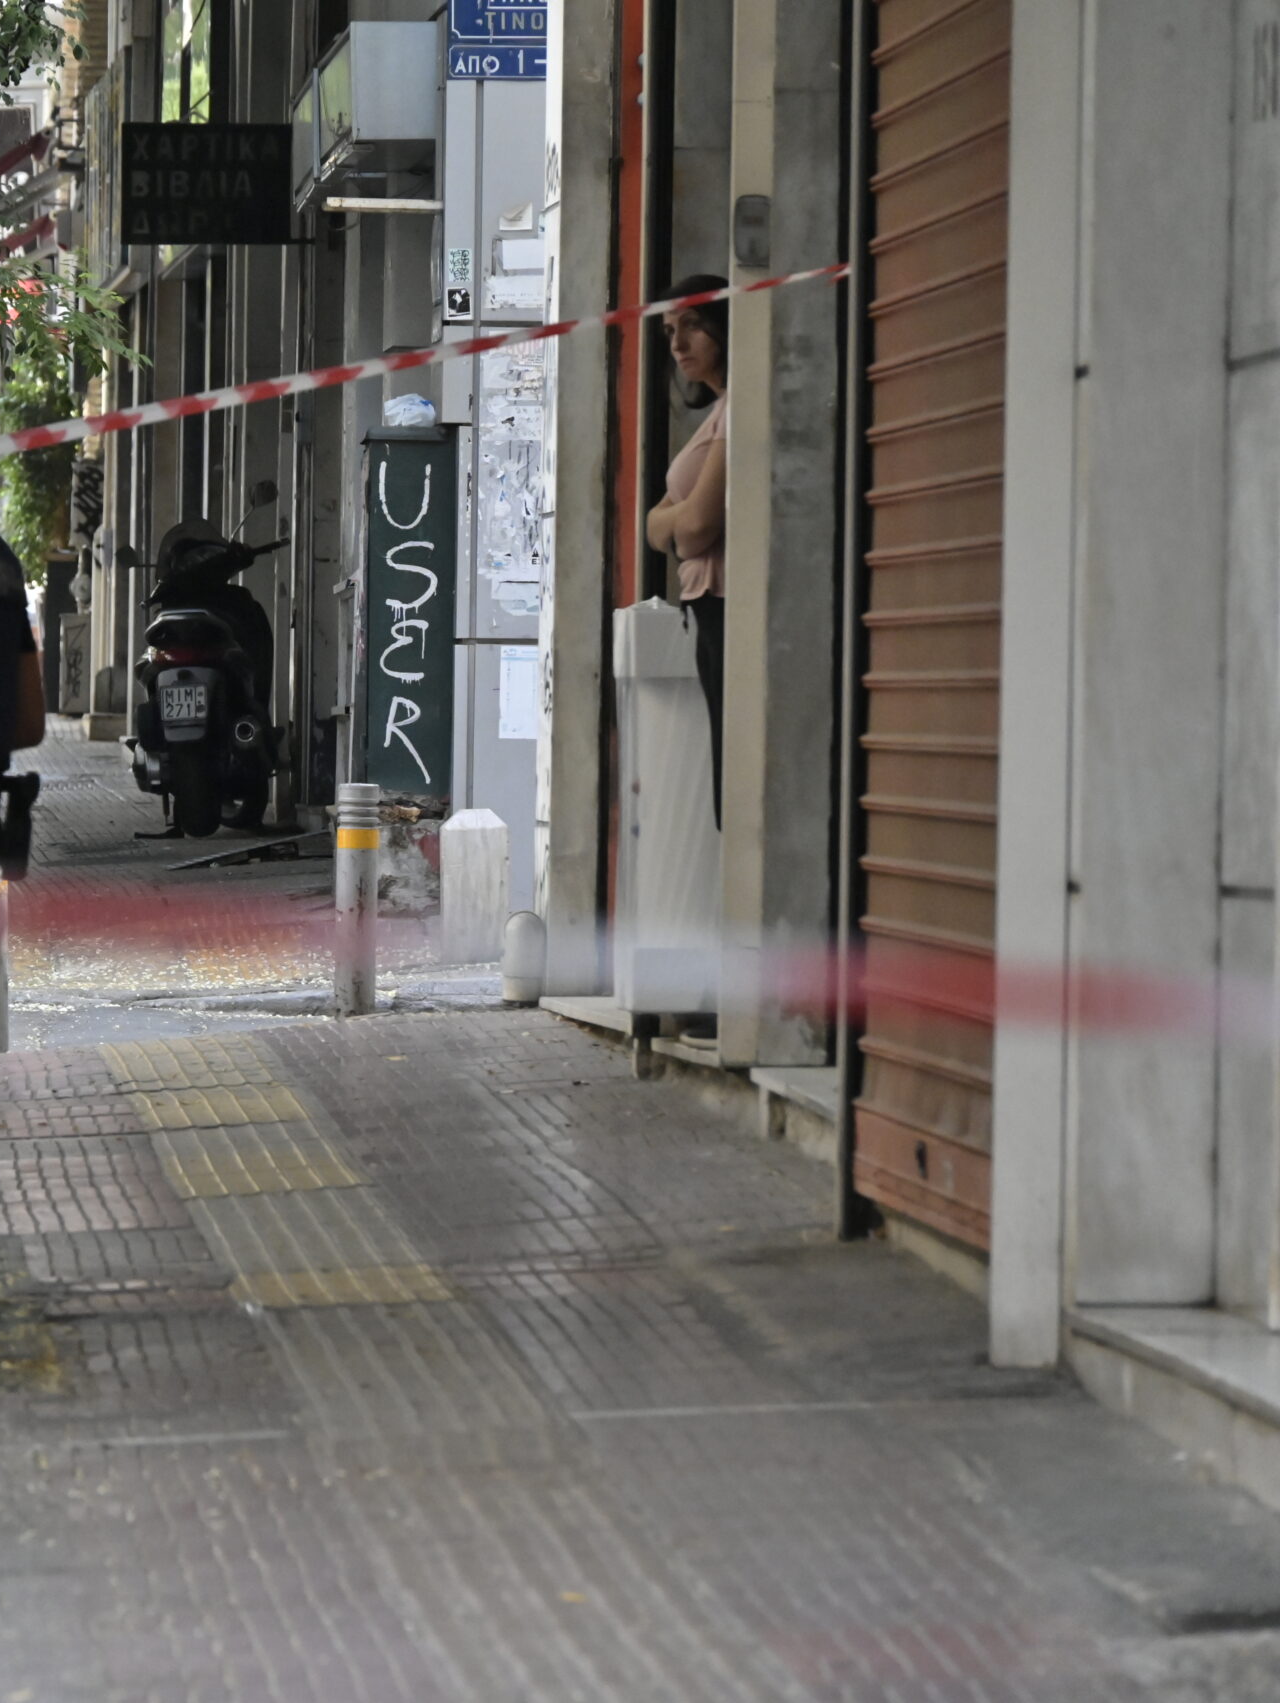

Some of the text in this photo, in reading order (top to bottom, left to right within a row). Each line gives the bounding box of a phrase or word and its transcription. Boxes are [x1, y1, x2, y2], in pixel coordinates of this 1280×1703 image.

[455, 54, 500, 75] ΑΠΟ
[132, 132, 279, 160] ΧΑΡΤΙΚΑ
[131, 169, 253, 198] ΒΙΒΛΙΑ
[378, 460, 439, 785] USER
[166, 703, 192, 718] 271
